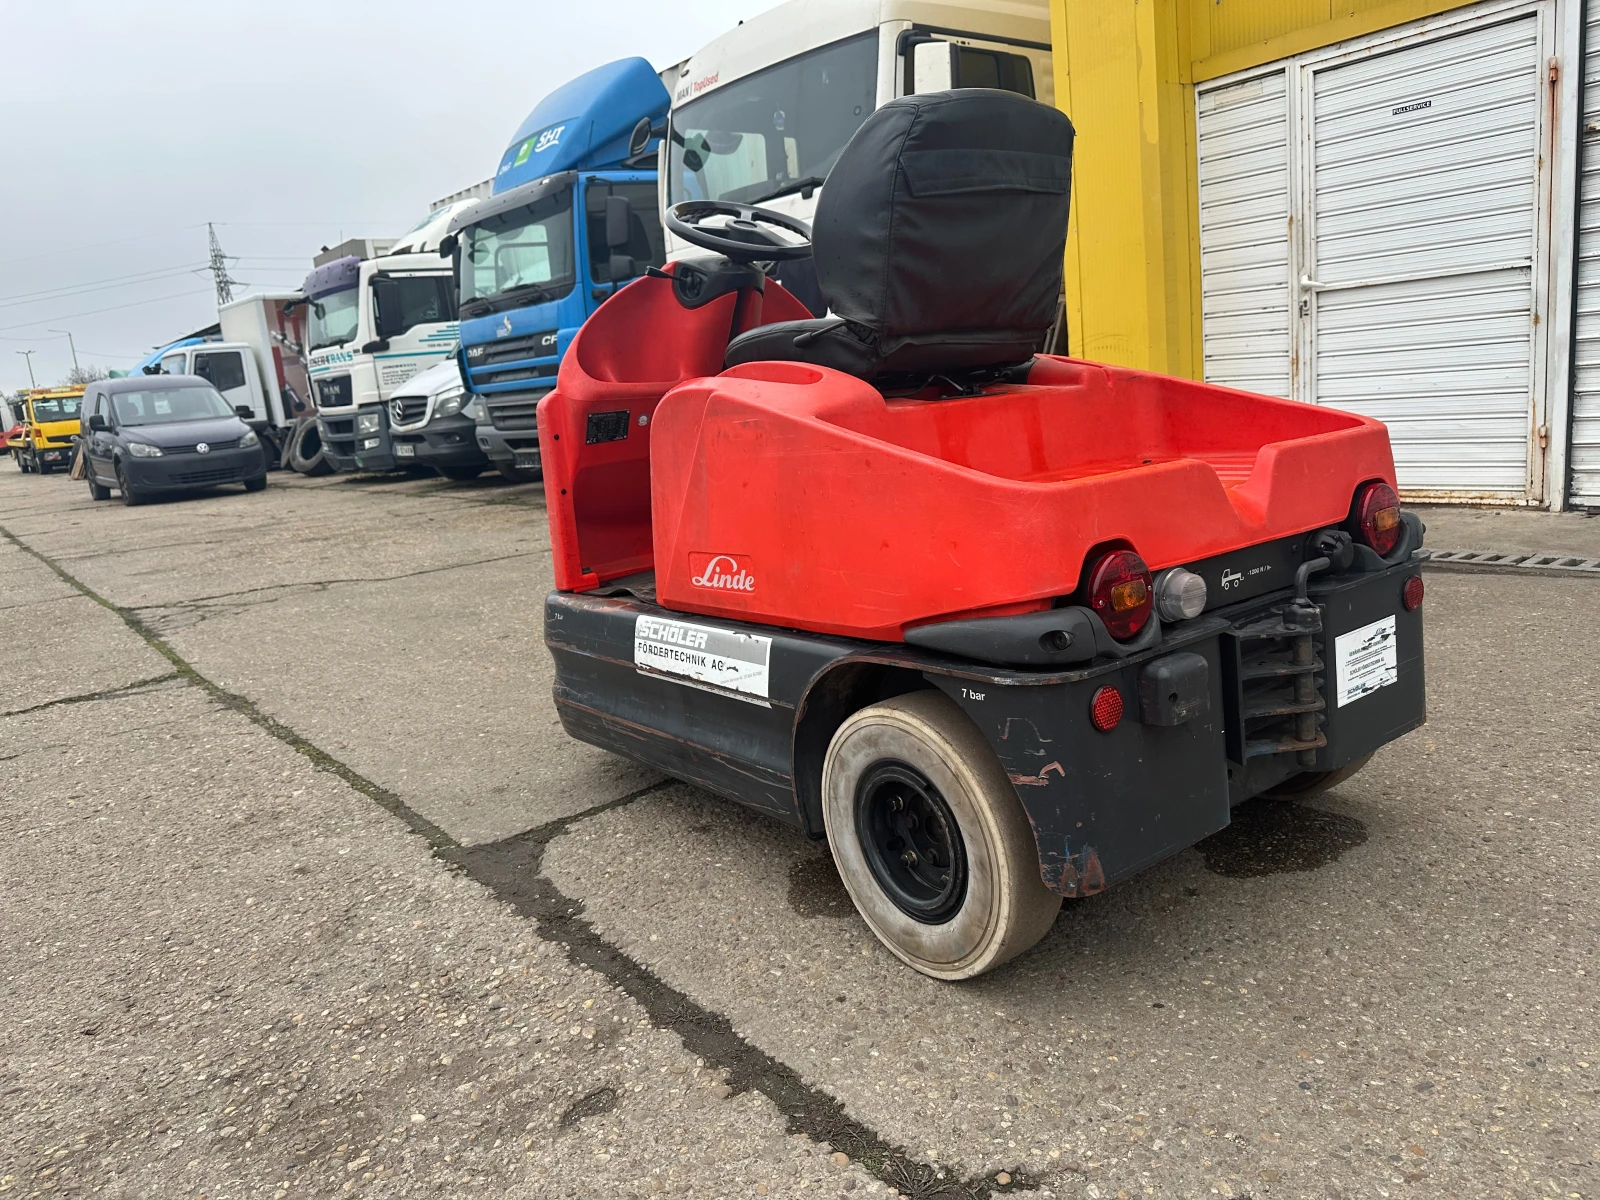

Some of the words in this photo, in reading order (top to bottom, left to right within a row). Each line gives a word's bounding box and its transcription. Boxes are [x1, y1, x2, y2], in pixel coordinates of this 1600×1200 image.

[676, 86, 690, 102] MAN
[693, 71, 719, 92] TopUsed
[1392, 101, 1431, 115] FULLSERVICE
[536, 126, 566, 148] SHT
[467, 347, 484, 358] DAF
[323, 385, 340, 396] MAN
[691, 555, 756, 592] Linde
[639, 620, 709, 650] SCHÖLER
[638, 642, 707, 668] FÖRDERTECHNIK
[711, 660, 724, 672] AG
[961, 688, 967, 698] 7
[969, 689, 986, 701] bar
